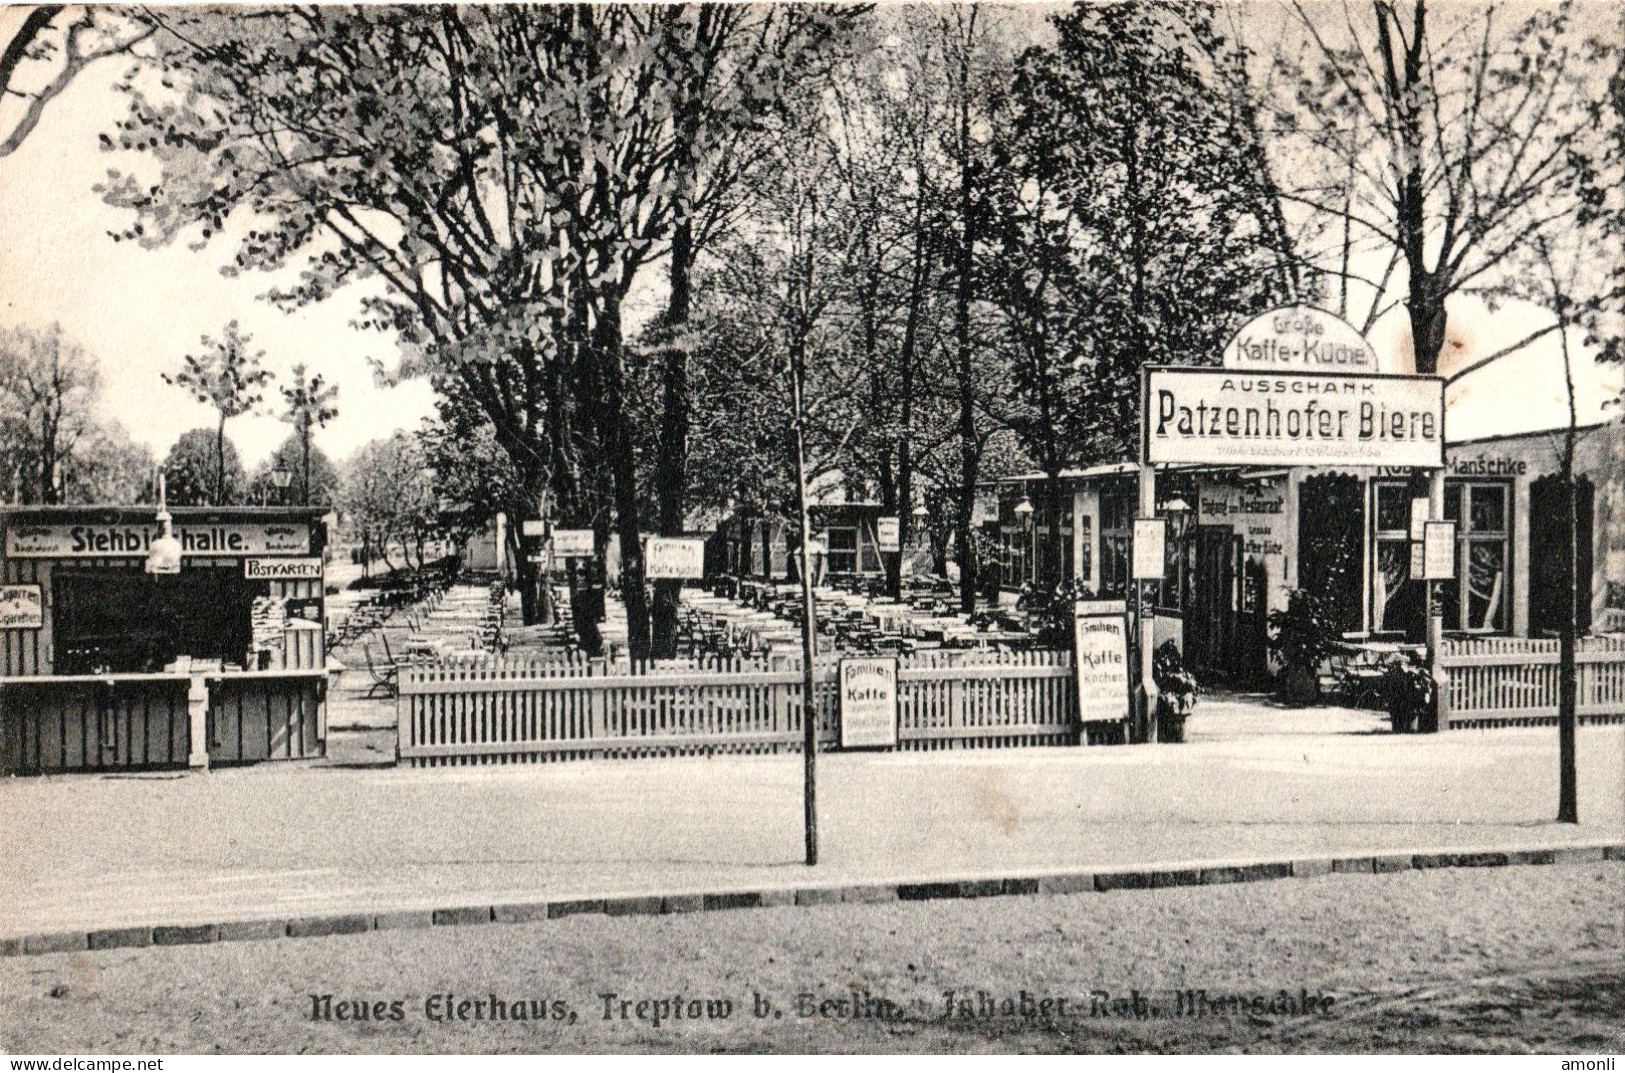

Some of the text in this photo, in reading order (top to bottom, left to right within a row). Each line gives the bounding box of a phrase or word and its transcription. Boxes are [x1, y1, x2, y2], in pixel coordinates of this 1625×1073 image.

[1220, 378, 1375, 396] AUSSCHANK
[1156, 388, 1437, 442] Patzenhofer Biere
[1083, 650, 1122, 668] Kaffe
[845, 661, 892, 684] Familien
[848, 688, 887, 702] Kaffe
